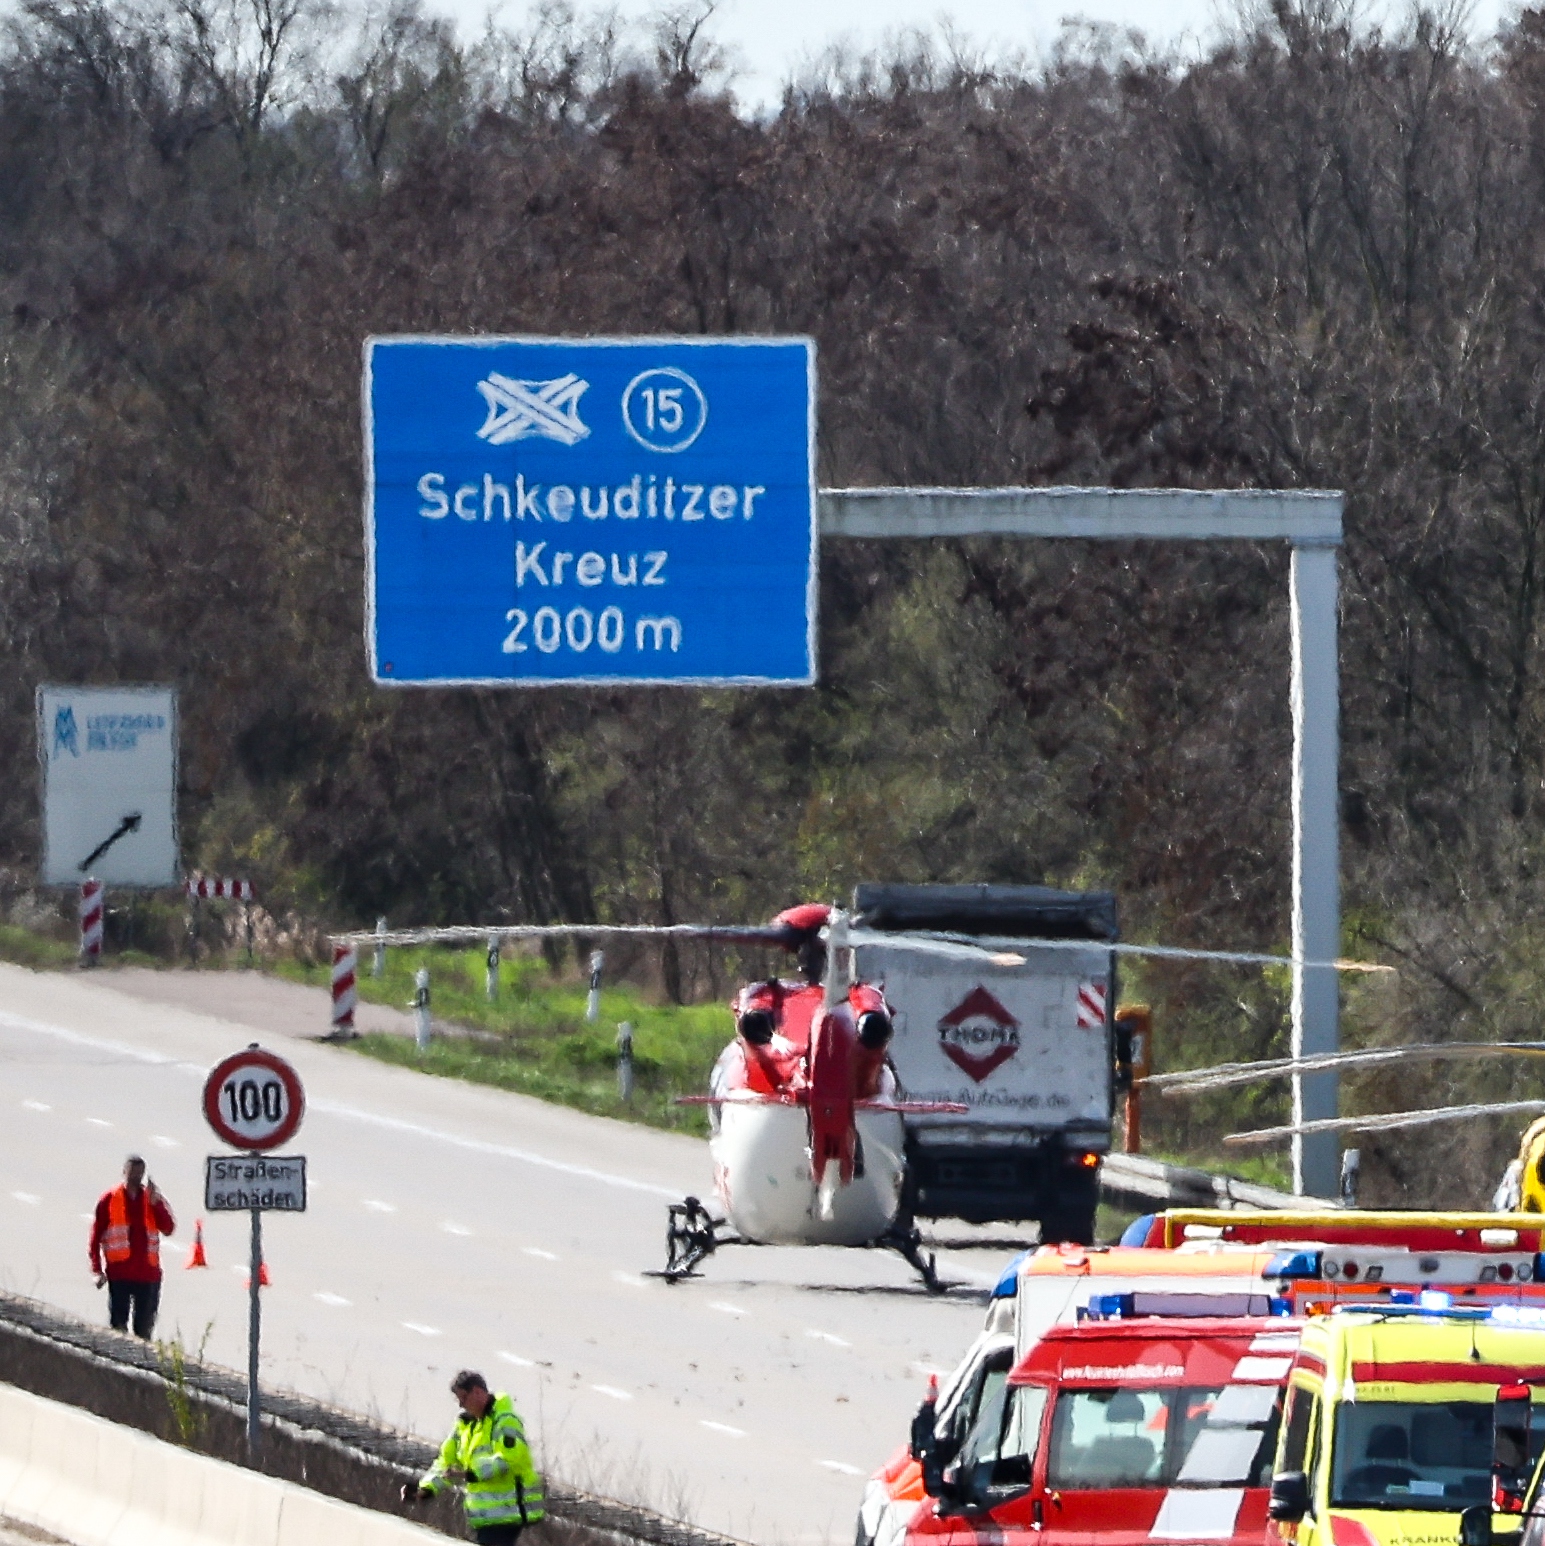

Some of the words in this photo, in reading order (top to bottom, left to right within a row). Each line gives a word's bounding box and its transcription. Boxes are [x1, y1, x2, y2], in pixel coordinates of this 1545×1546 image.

[641, 387, 684, 433] 15
[416, 472, 766, 523] Schkeuditzer
[515, 540, 669, 588] Kreuz
[502, 605, 625, 654] 2000
[635, 613, 683, 653] m
[224, 1080, 283, 1123] 100
[214, 1161, 299, 1181] Straßen-
[213, 1187, 296, 1208] schäden
